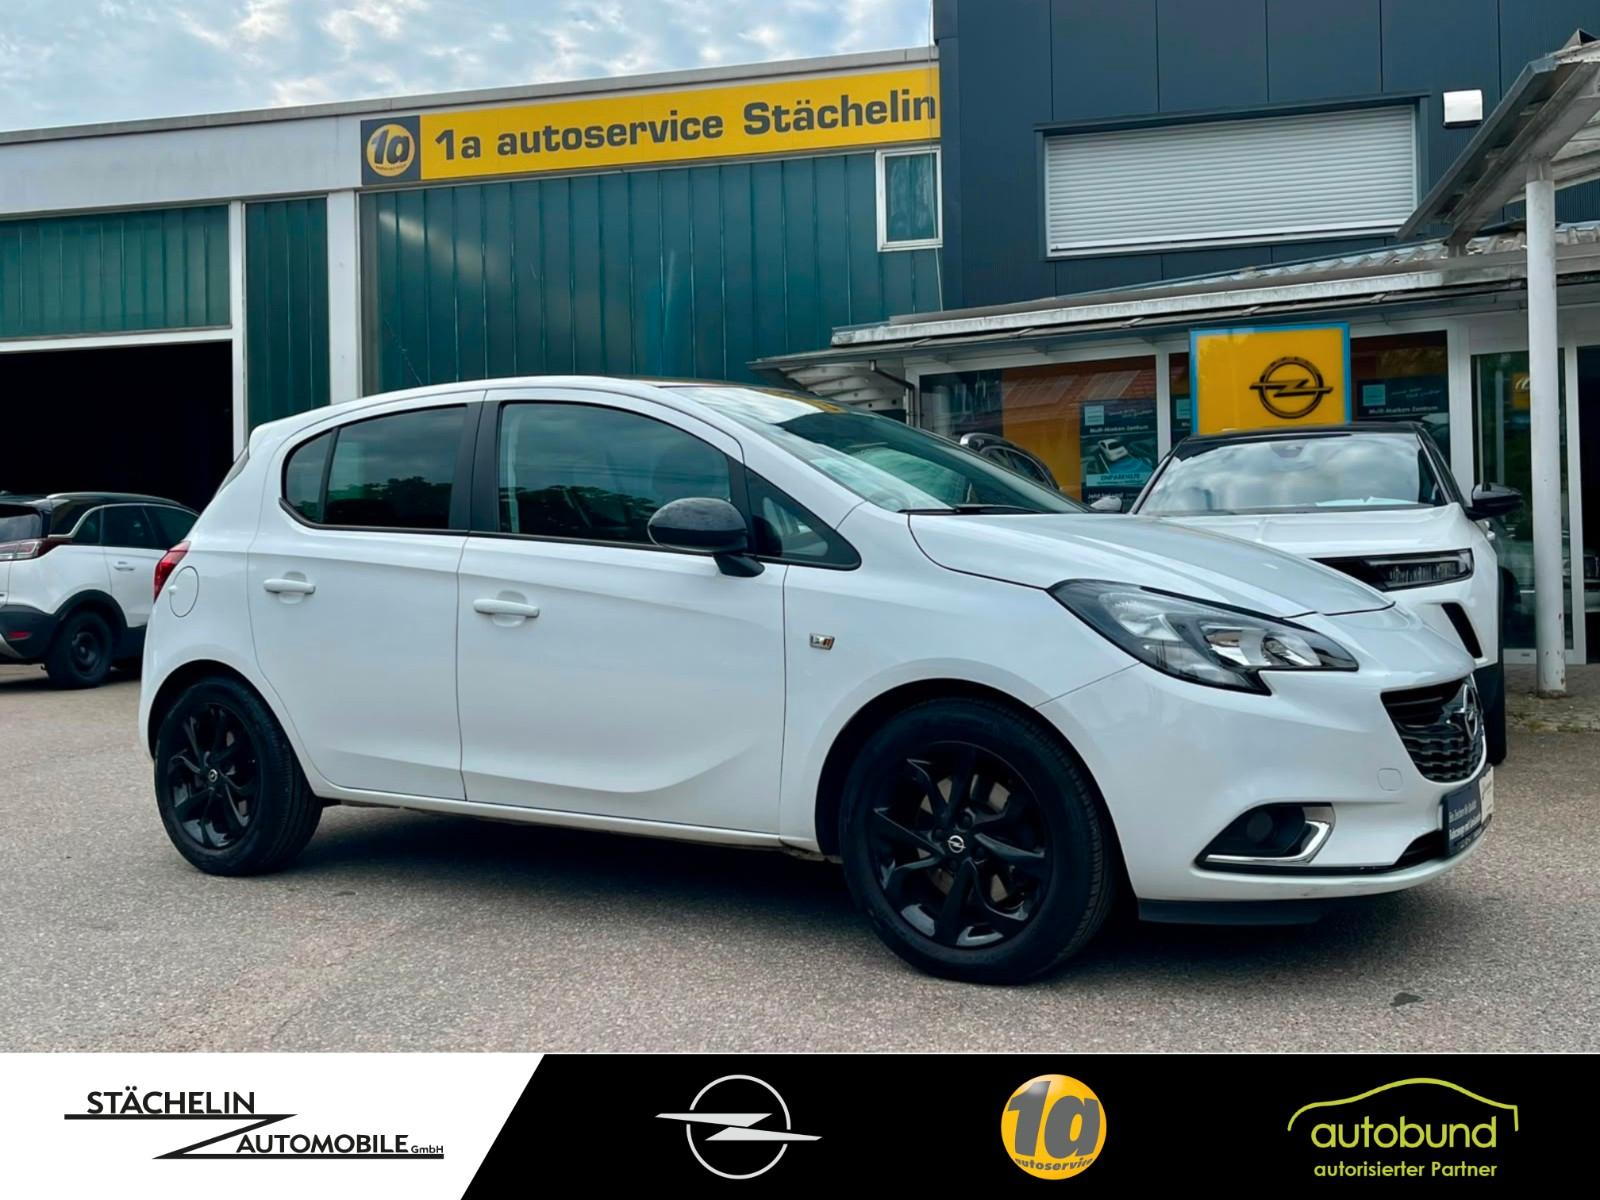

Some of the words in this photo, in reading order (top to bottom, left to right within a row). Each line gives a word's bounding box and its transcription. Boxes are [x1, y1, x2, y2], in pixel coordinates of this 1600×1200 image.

[371, 130, 410, 165] 1a
[435, 129, 481, 160] 1a
[497, 110, 723, 155] autoservice
[743, 88, 936, 135] Stächelin
